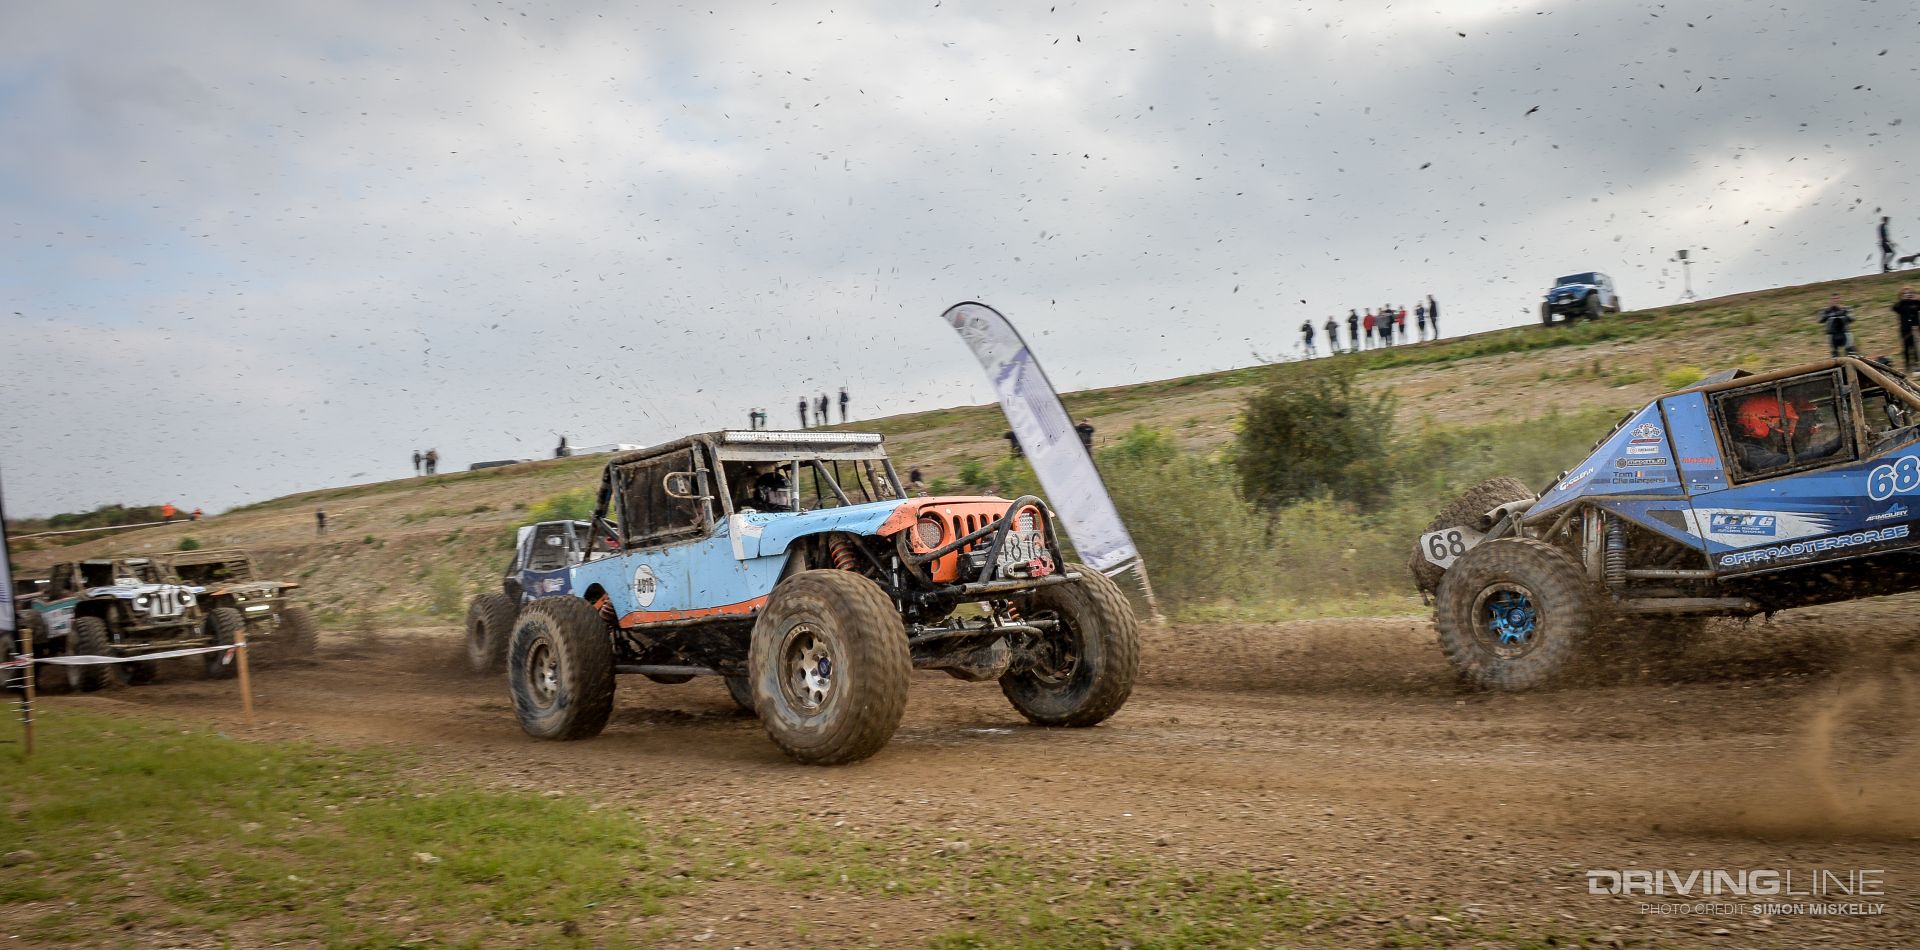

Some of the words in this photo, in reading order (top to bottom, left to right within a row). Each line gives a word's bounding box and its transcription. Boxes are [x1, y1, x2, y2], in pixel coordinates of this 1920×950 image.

[1712, 515, 1774, 526] KING
[1866, 510, 1908, 521] ARMOURY
[1429, 531, 1465, 560] 68
[1720, 525, 1909, 566] OFFROADTERROR.BE
